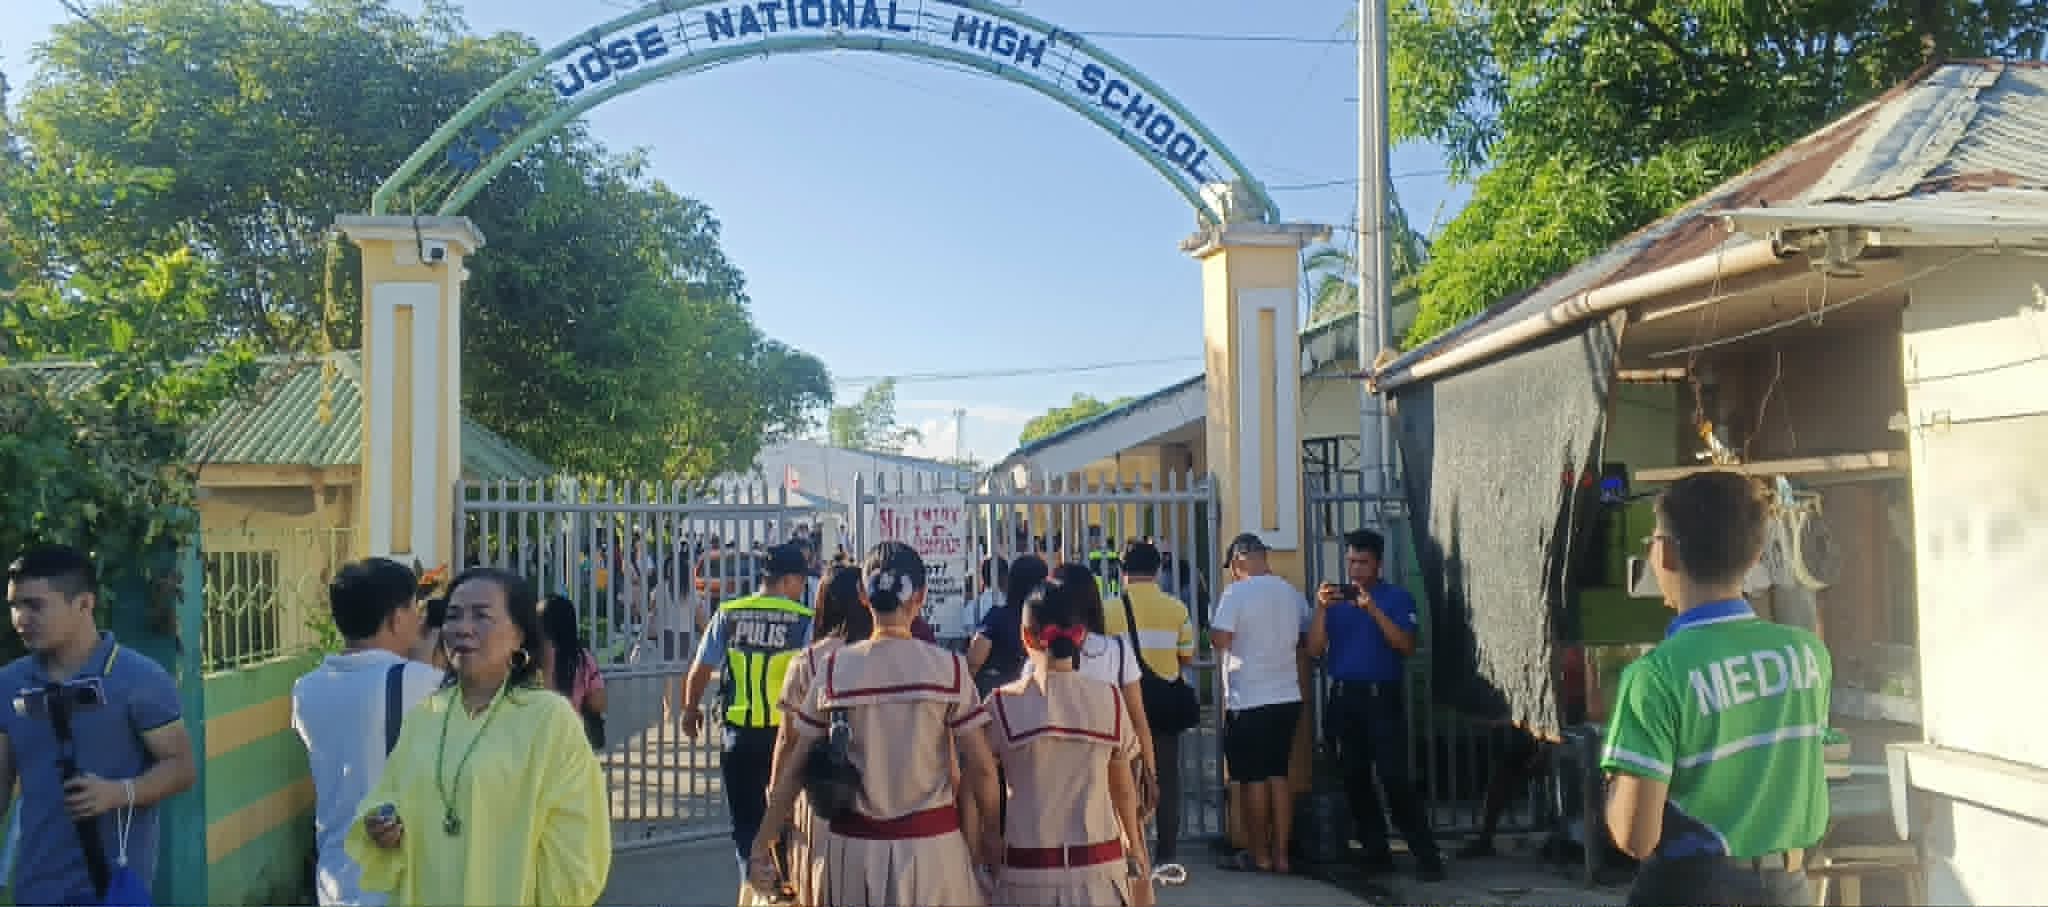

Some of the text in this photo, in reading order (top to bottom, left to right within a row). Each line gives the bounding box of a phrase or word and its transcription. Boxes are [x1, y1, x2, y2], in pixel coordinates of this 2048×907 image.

[554, 26, 668, 97] JOSE
[704, 0, 911, 41] NATIONAL
[951, 15, 1047, 69] HIGH
[1076, 63, 1210, 183] SCHOOL
[735, 620, 788, 648] PULIS
[1688, 643, 1825, 717] MEDIA
